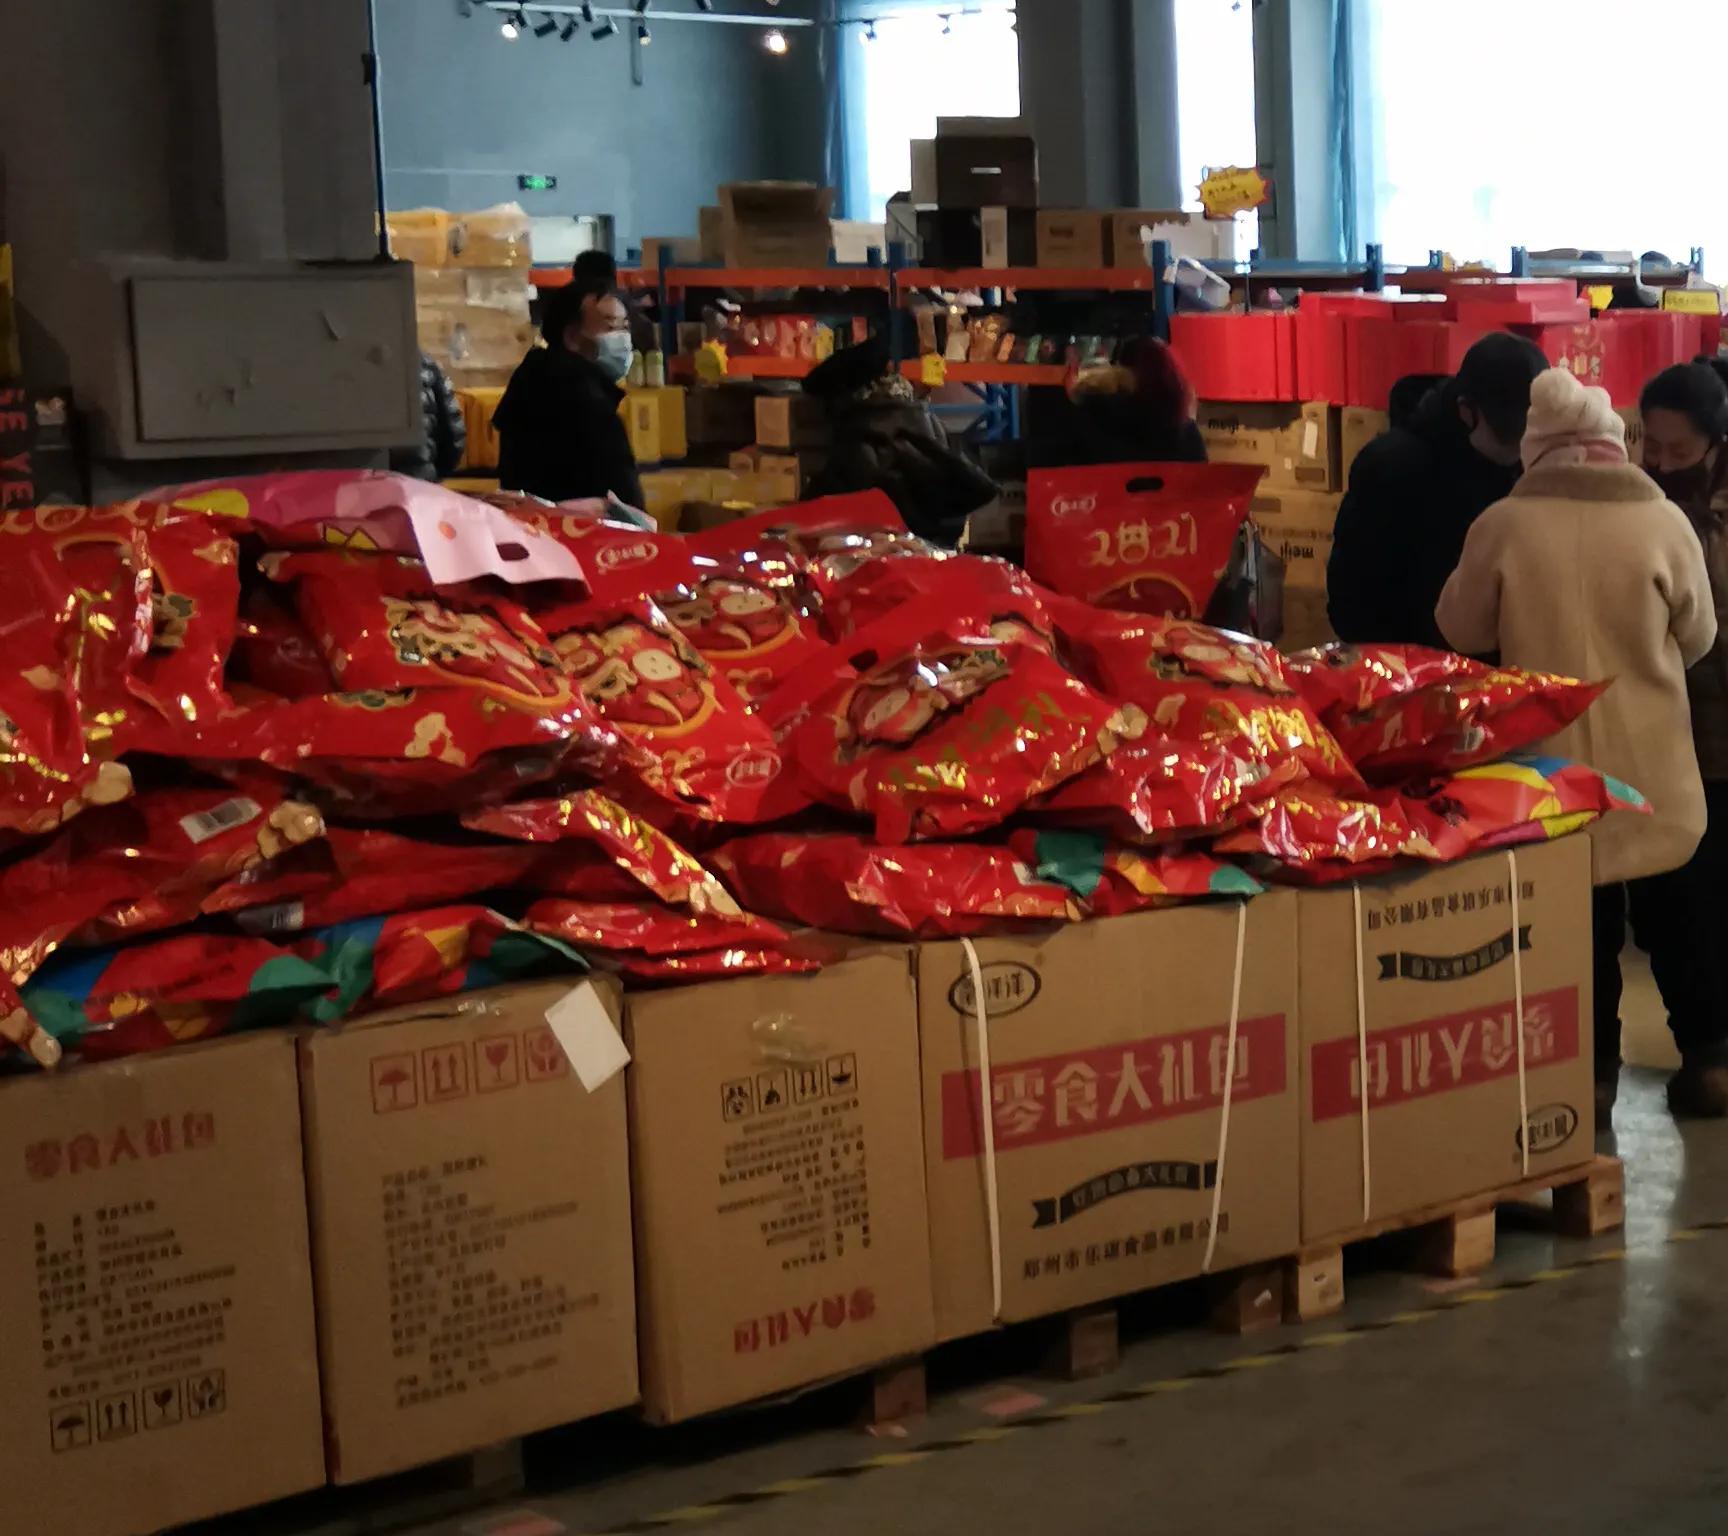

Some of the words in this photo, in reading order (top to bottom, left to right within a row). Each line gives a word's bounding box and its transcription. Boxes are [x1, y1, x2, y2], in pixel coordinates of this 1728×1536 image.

[992, 1034, 1250, 1137] 零食大礼包
